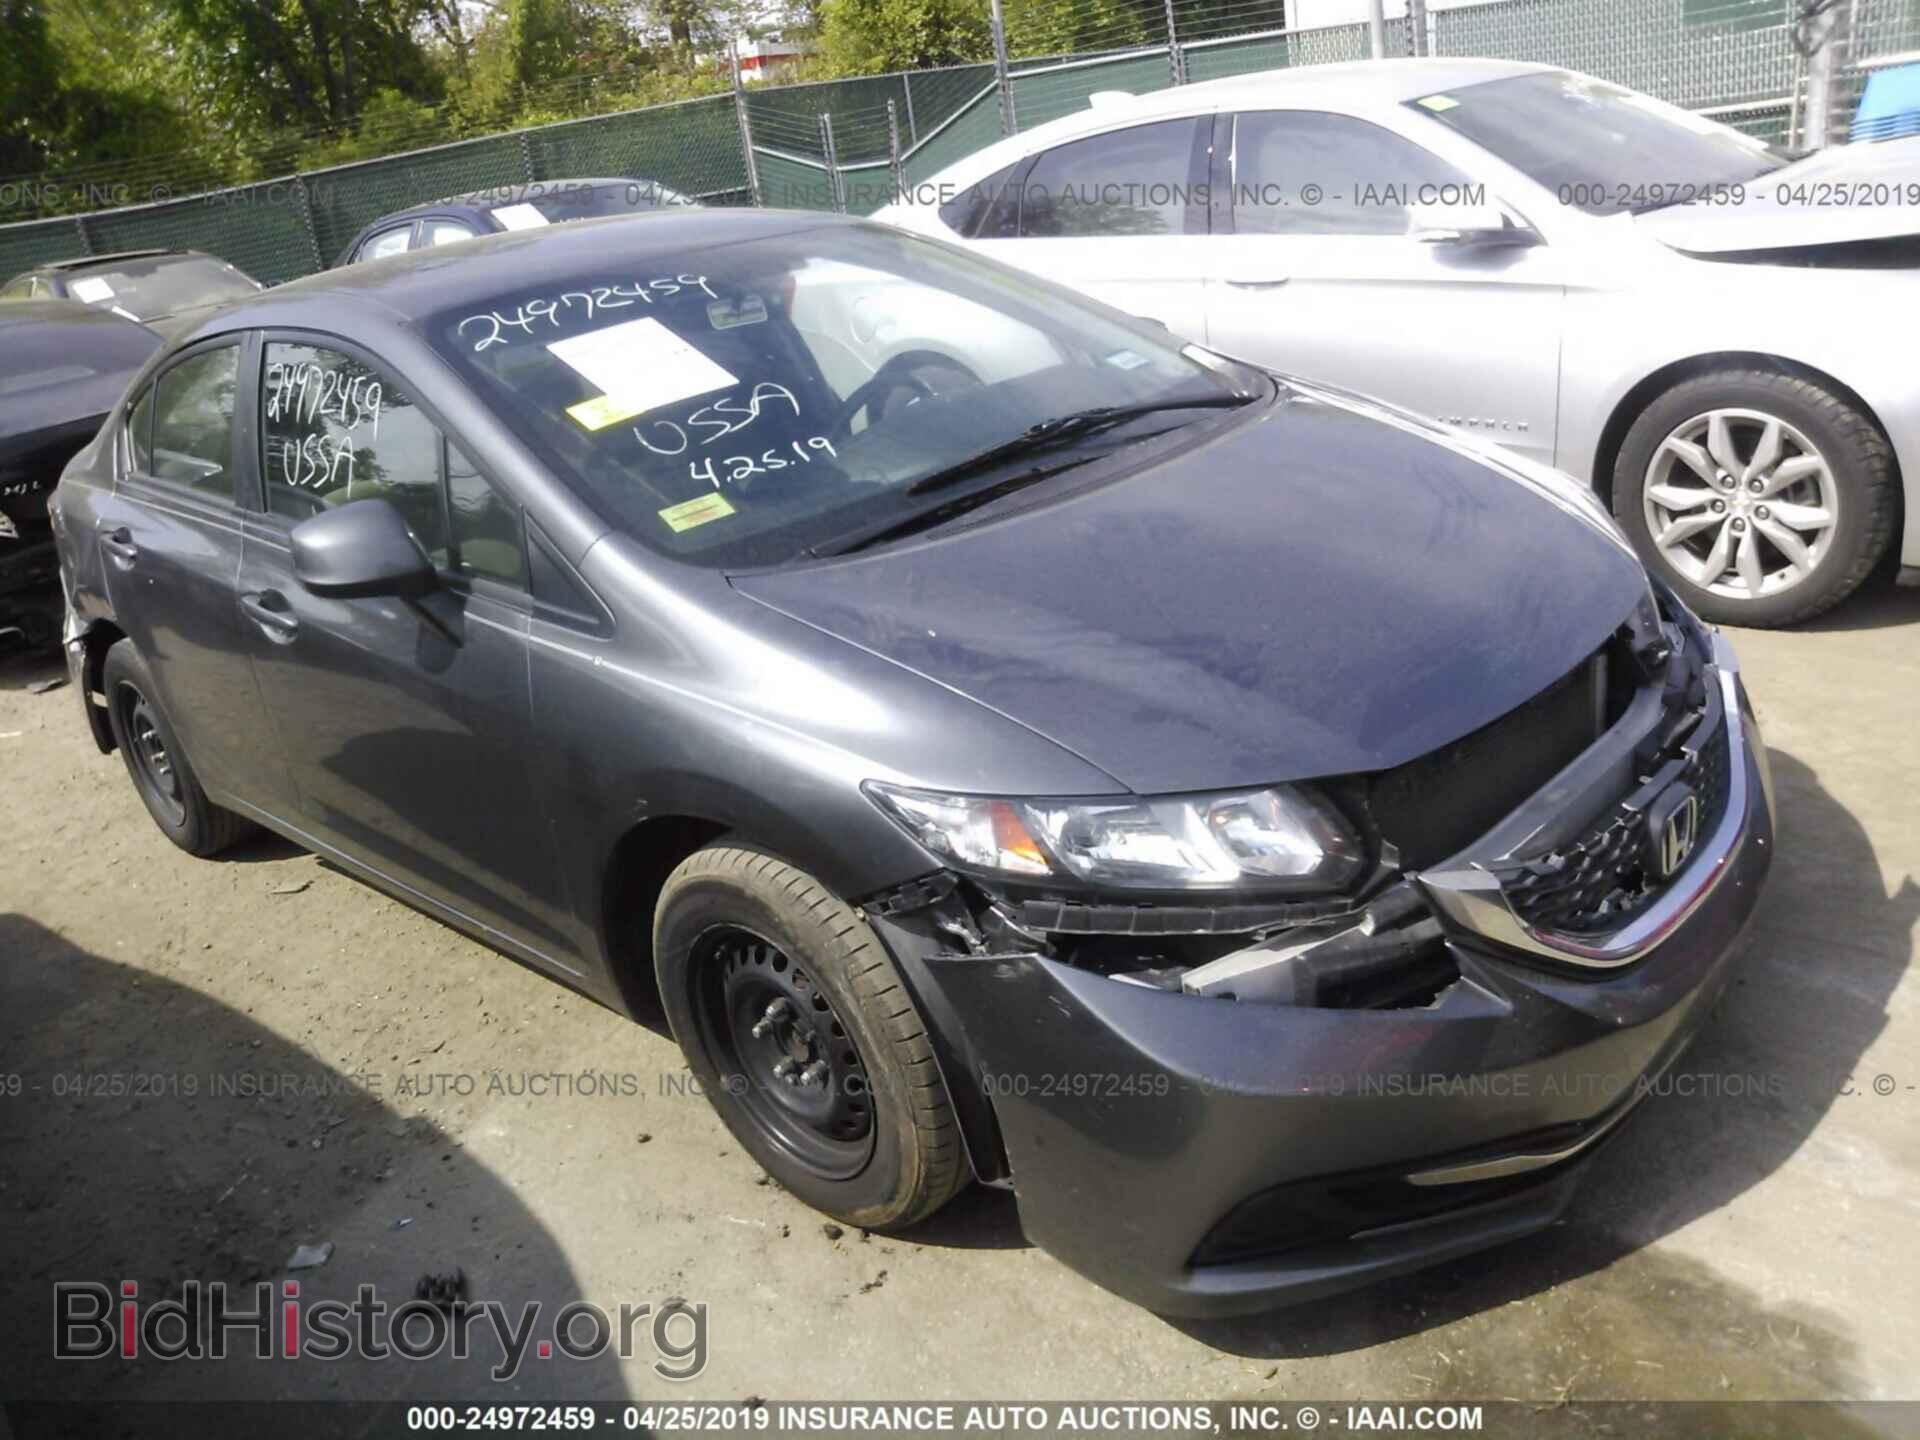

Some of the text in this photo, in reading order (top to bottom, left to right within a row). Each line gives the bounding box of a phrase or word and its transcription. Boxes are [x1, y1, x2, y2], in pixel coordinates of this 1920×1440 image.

[457, 273, 718, 352] 24972459
[267, 362, 383, 441] 24972459
[633, 382, 801, 455] USSA
[283, 433, 357, 498] USSA
[688, 436, 837, 488] 4.25.19
